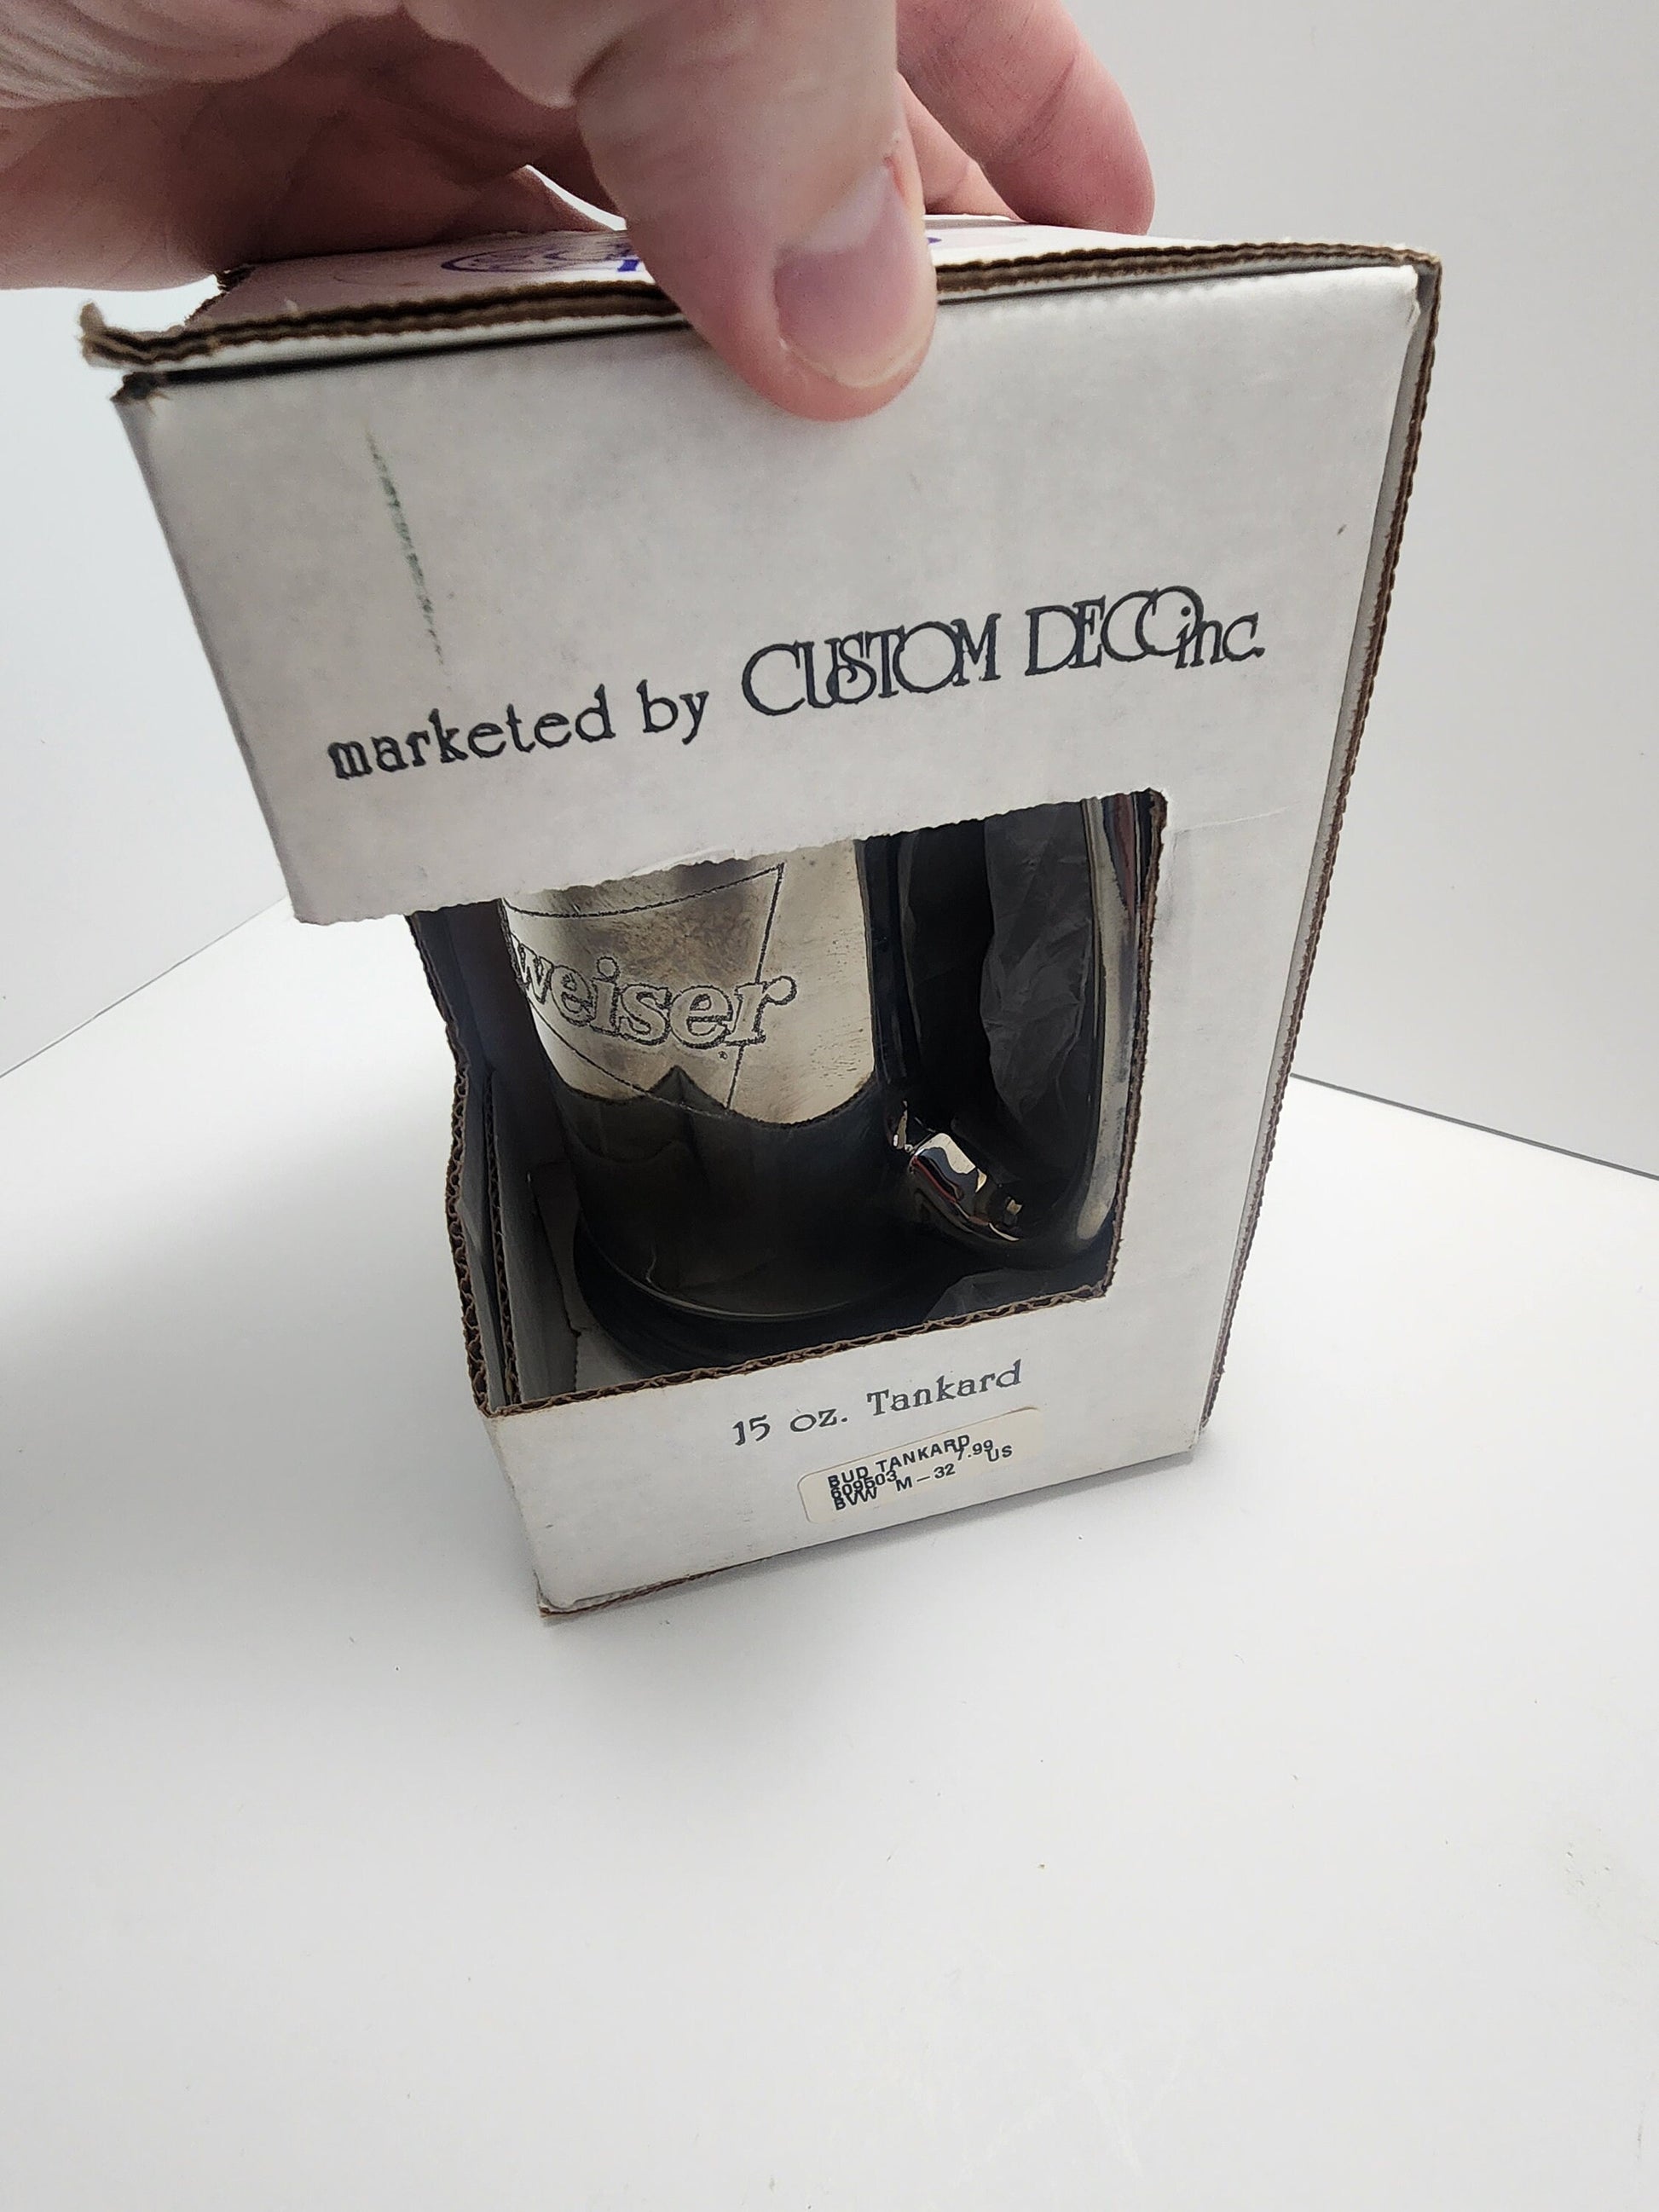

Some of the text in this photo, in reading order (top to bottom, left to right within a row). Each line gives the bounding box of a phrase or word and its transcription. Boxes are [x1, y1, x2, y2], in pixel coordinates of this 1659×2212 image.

[328, 684, 616, 780] marketed
[637, 679, 708, 744] by
[742, 613, 1002, 716] CUSTOM
[732, 1359, 1022, 1446] 15 oz. Tankard
[828, 1434, 970, 1488] BUD TANKARD
